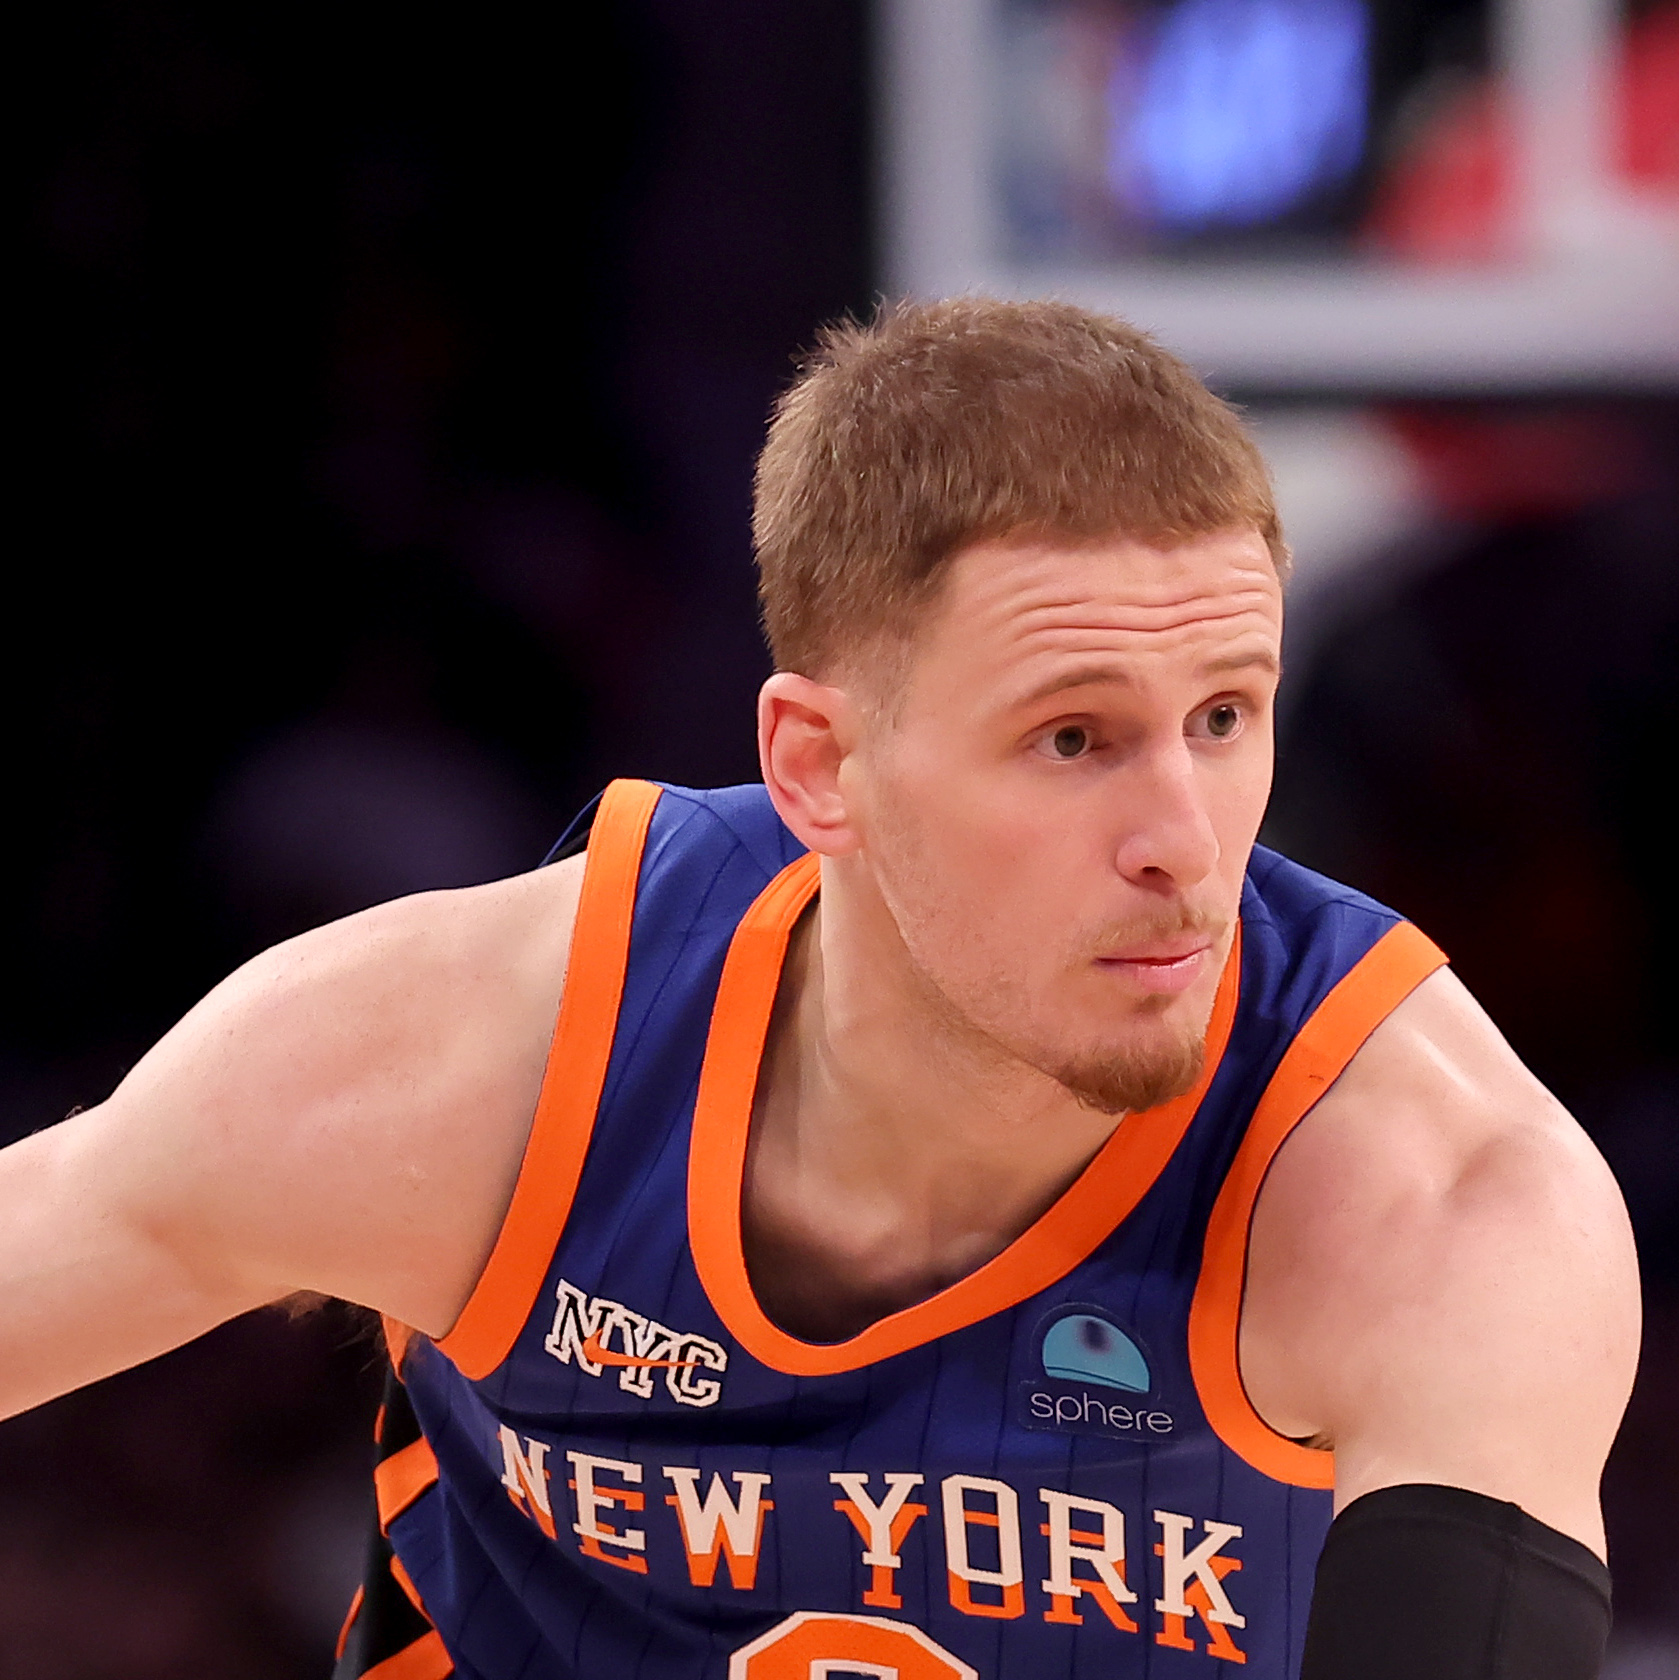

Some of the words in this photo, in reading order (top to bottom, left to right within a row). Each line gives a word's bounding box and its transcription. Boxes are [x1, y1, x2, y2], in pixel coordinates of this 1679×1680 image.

[544, 1277, 728, 1408] NYC
[1031, 1392, 1173, 1433] sphere
[498, 1424, 774, 1590] NEW
[830, 1472, 1246, 1664] YORK
